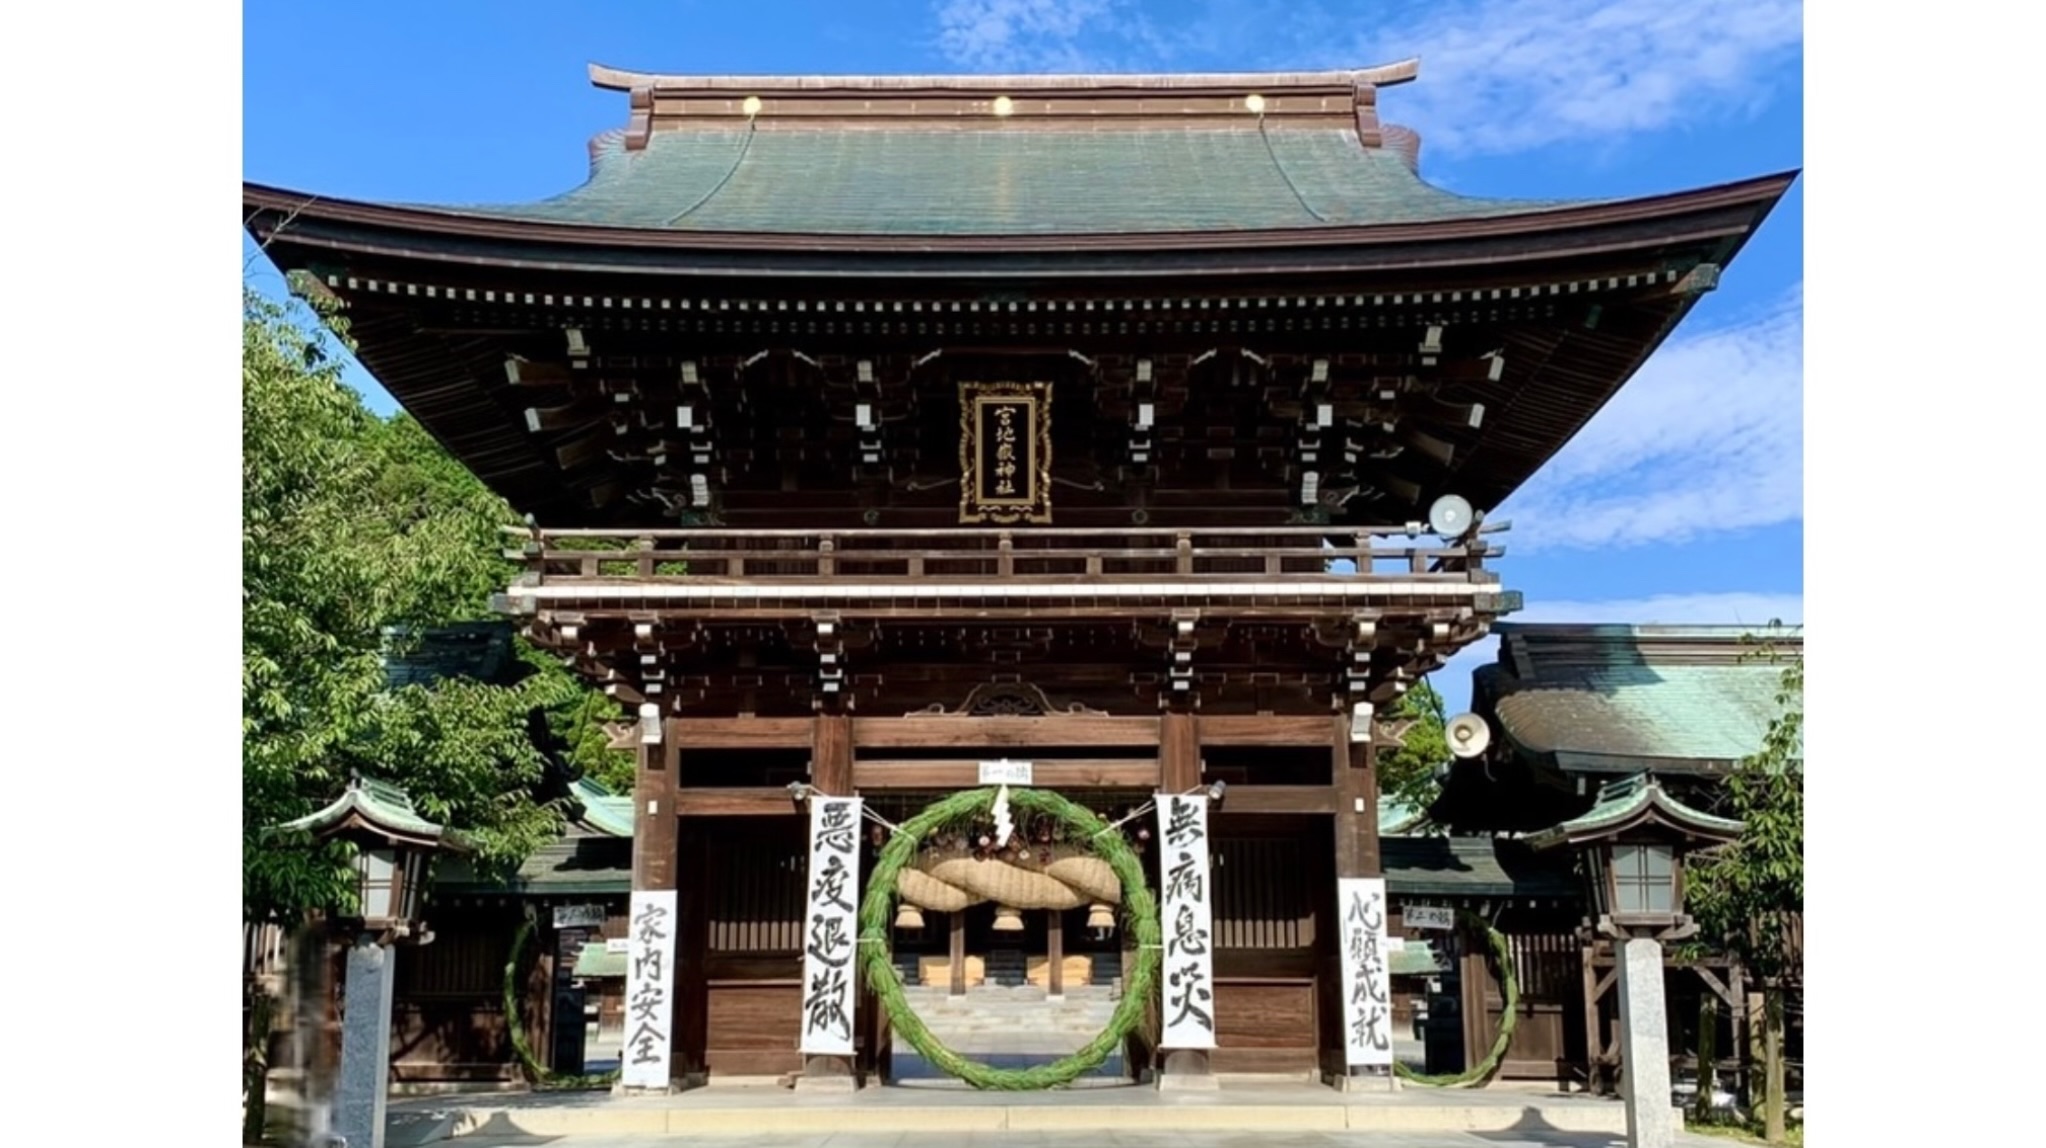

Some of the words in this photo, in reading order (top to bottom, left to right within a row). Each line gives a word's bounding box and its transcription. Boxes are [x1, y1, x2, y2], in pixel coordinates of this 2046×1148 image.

[994, 405, 1017, 495] 宮地嶽神社
[628, 903, 667, 1065] 家内安全
[805, 803, 854, 1041] 悪疫退散
[1165, 796, 1212, 1033] 無病息災
[1348, 891, 1389, 1051] 心願成就
